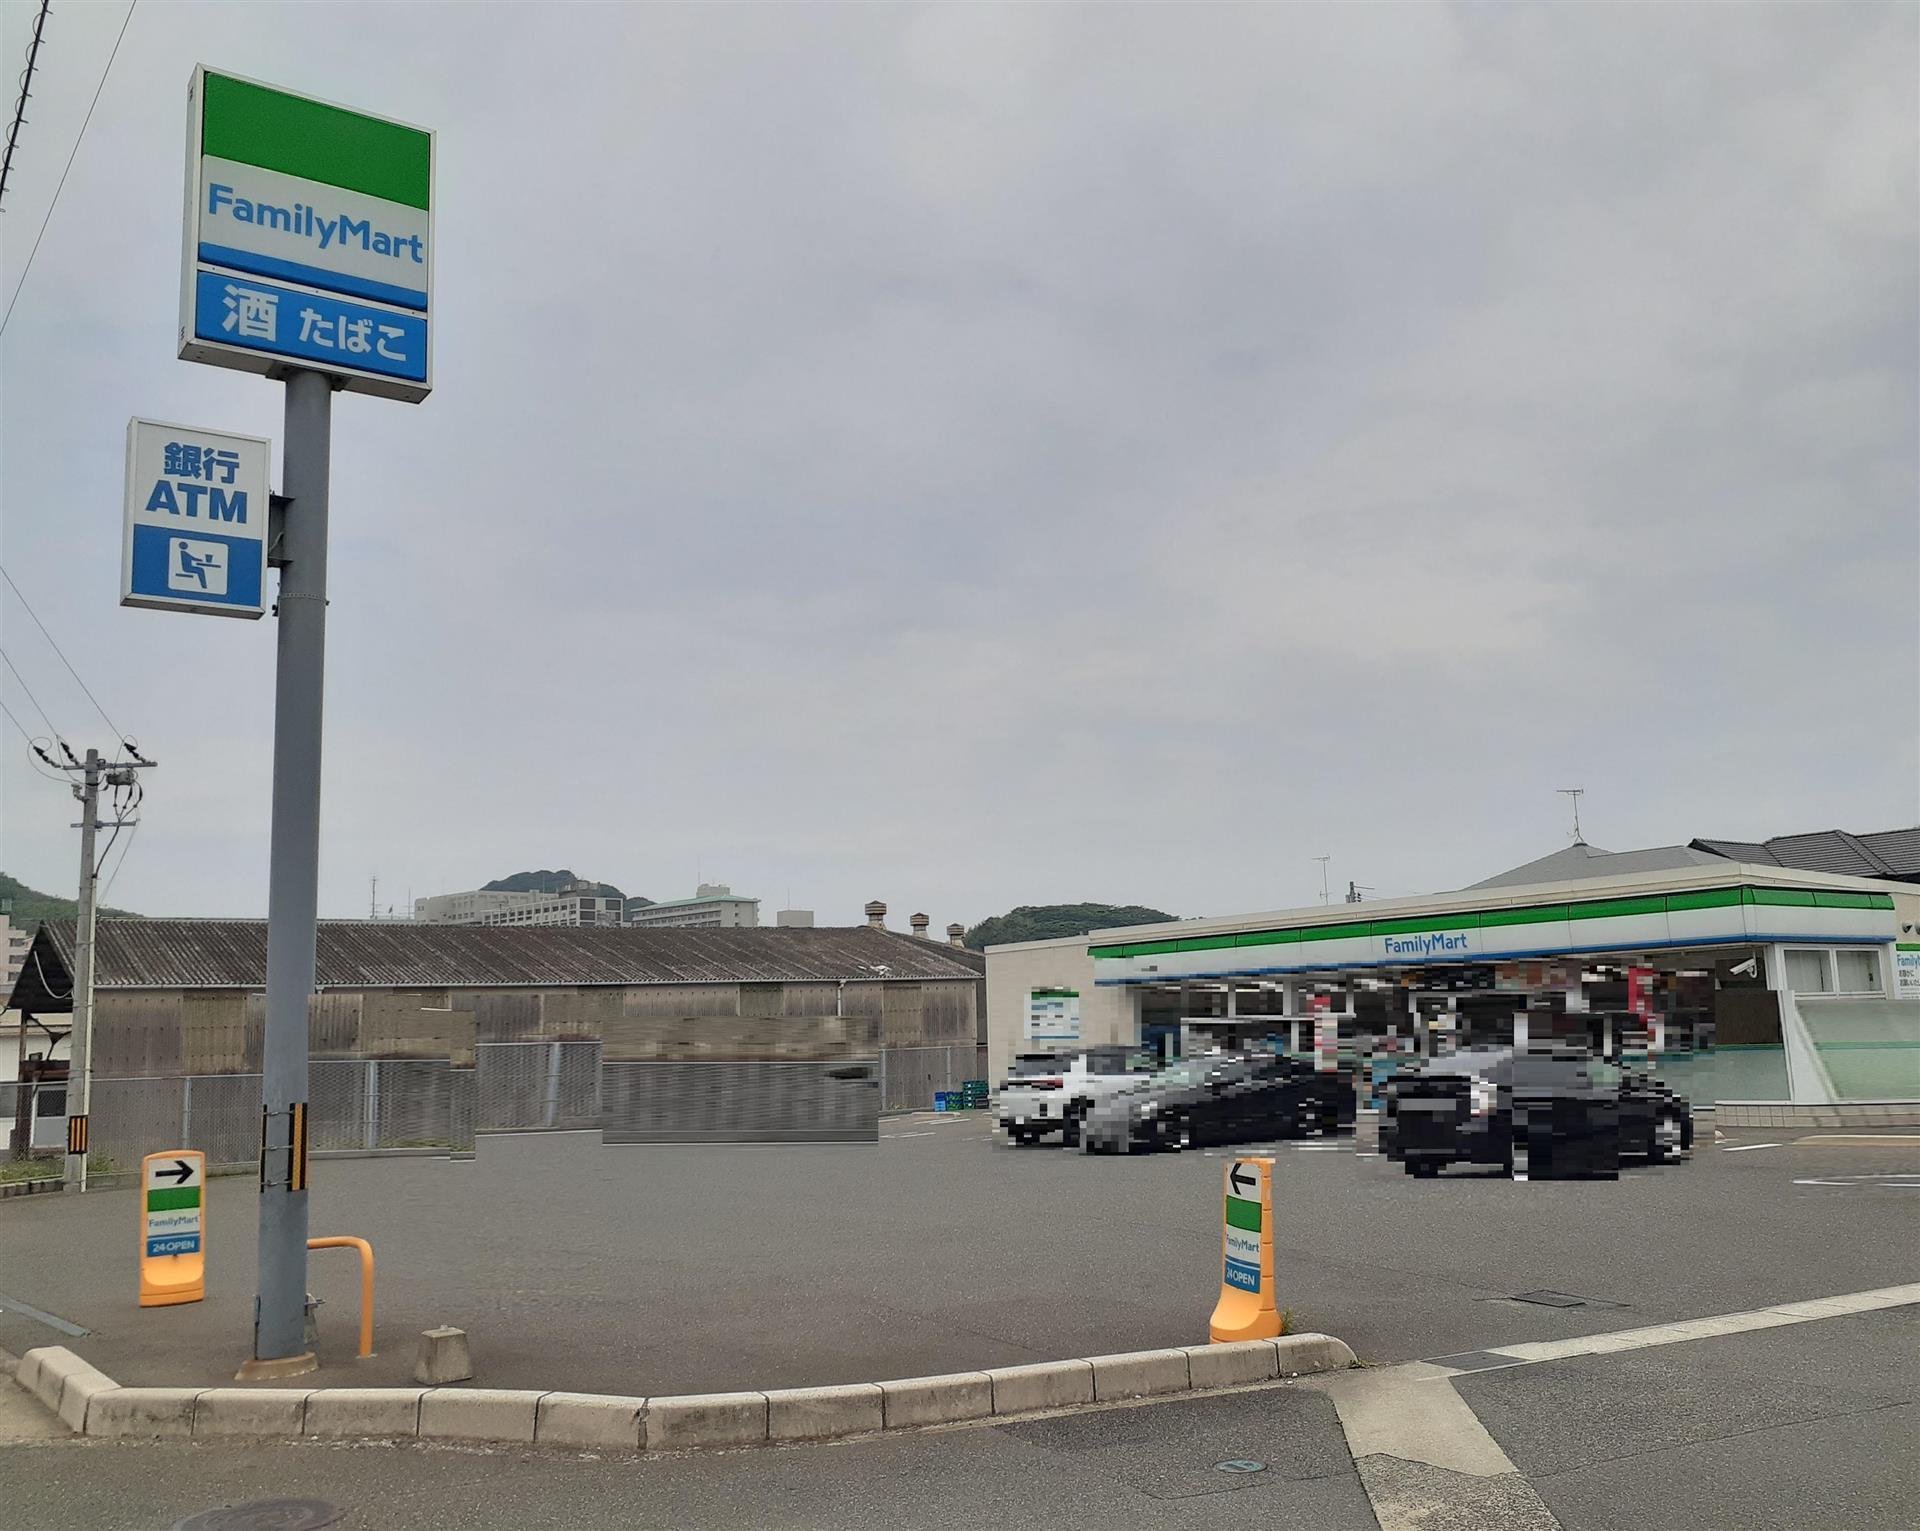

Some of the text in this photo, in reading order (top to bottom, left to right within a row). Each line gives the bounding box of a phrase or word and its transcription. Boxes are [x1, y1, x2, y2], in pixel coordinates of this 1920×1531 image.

[209, 183, 423, 264] FamilyMart
[222, 284, 408, 362] 酒 たばこ
[164, 441, 240, 485] 銀行
[145, 479, 248, 524] ATM
[1384, 933, 1468, 955] FamilyMart
[148, 1215, 199, 1227] FamilyMart
